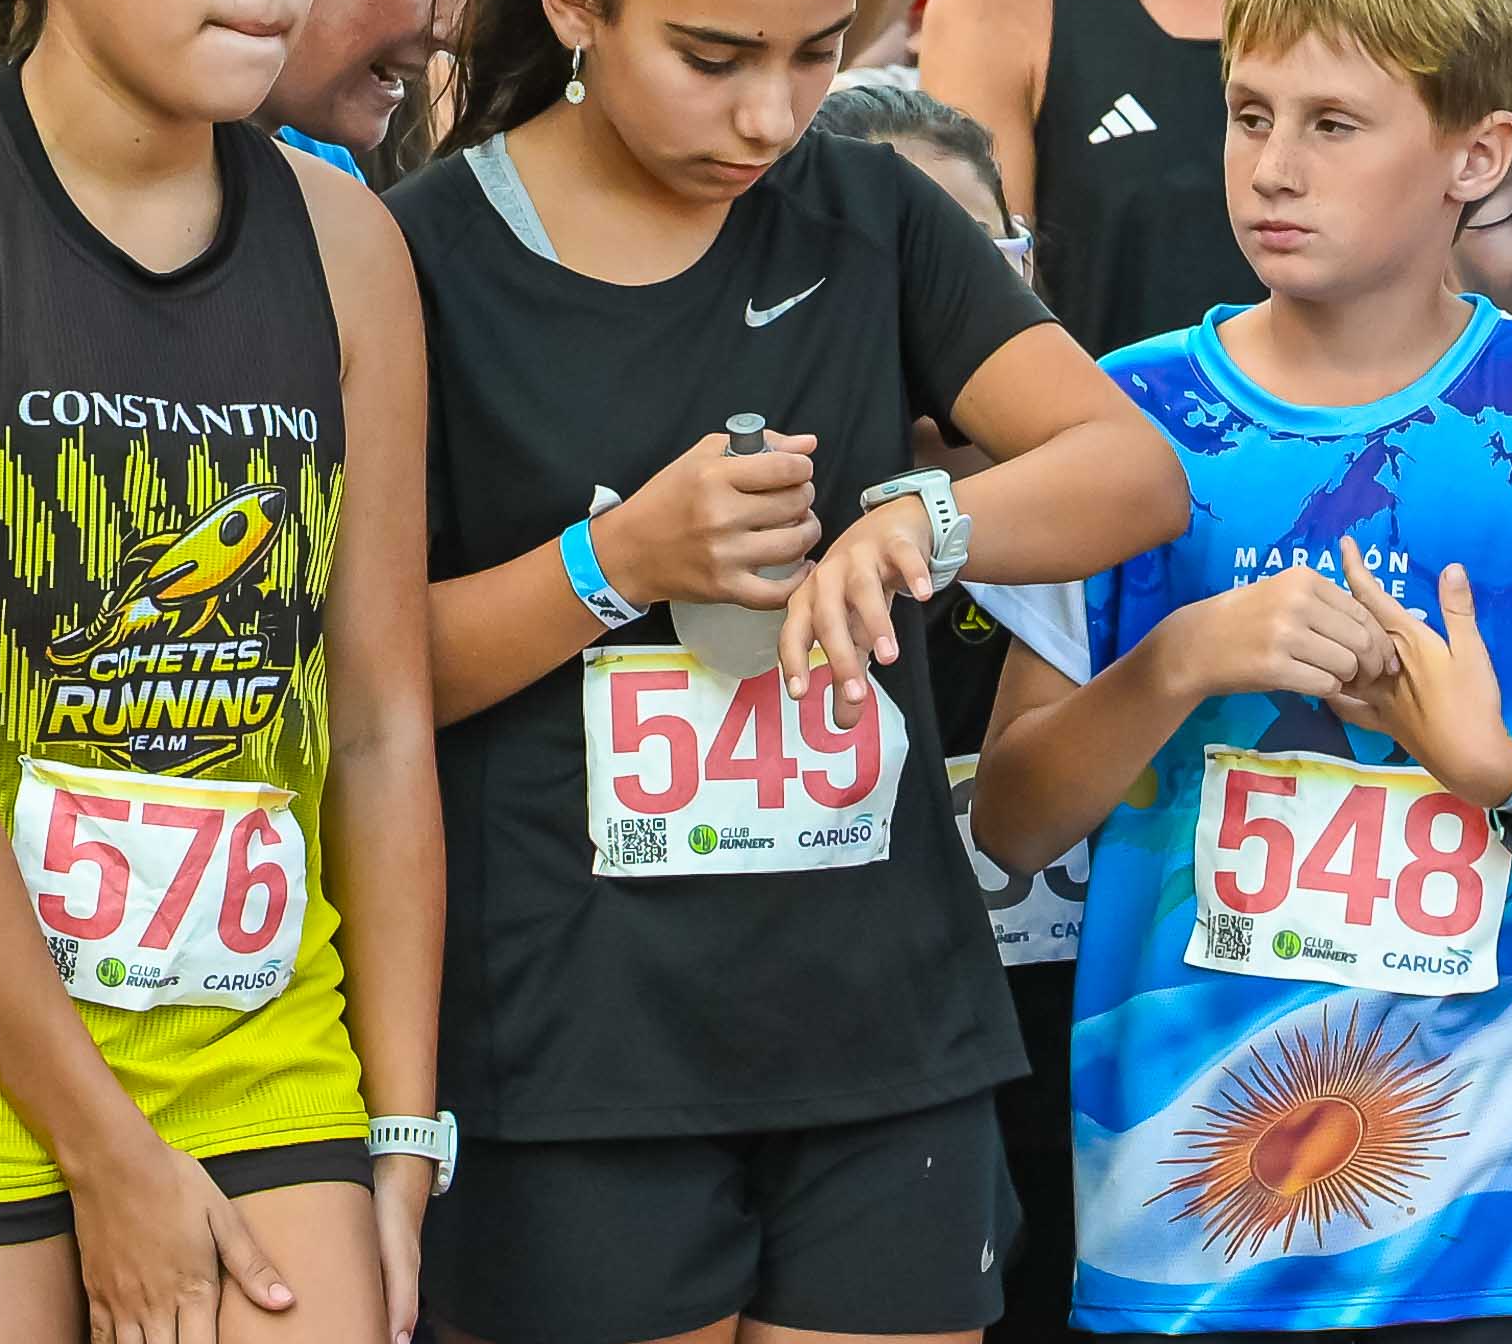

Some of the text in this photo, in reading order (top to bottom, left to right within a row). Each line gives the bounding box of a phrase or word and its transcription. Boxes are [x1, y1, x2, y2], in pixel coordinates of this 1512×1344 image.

[18, 389, 318, 443] CONSTANTINO
[1234, 544, 1409, 574] MARAÓN
[88, 638, 263, 682] COHETES
[46, 675, 281, 736] RUNNING
[129, 733, 188, 752] TEAM
[610, 664, 882, 815] 549
[719, 825, 872, 850] RUNNER'S CARUSO
[720, 827, 750, 839] CLUB
[1214, 768, 1490, 937] 548
[38, 788, 289, 955] 576
[1304, 937, 1333, 949] CLUB
[129, 964, 161, 977] CLUB
[1301, 946, 1471, 976] RUNNER'S CARUSO
[203, 971, 277, 991] CARUSO
